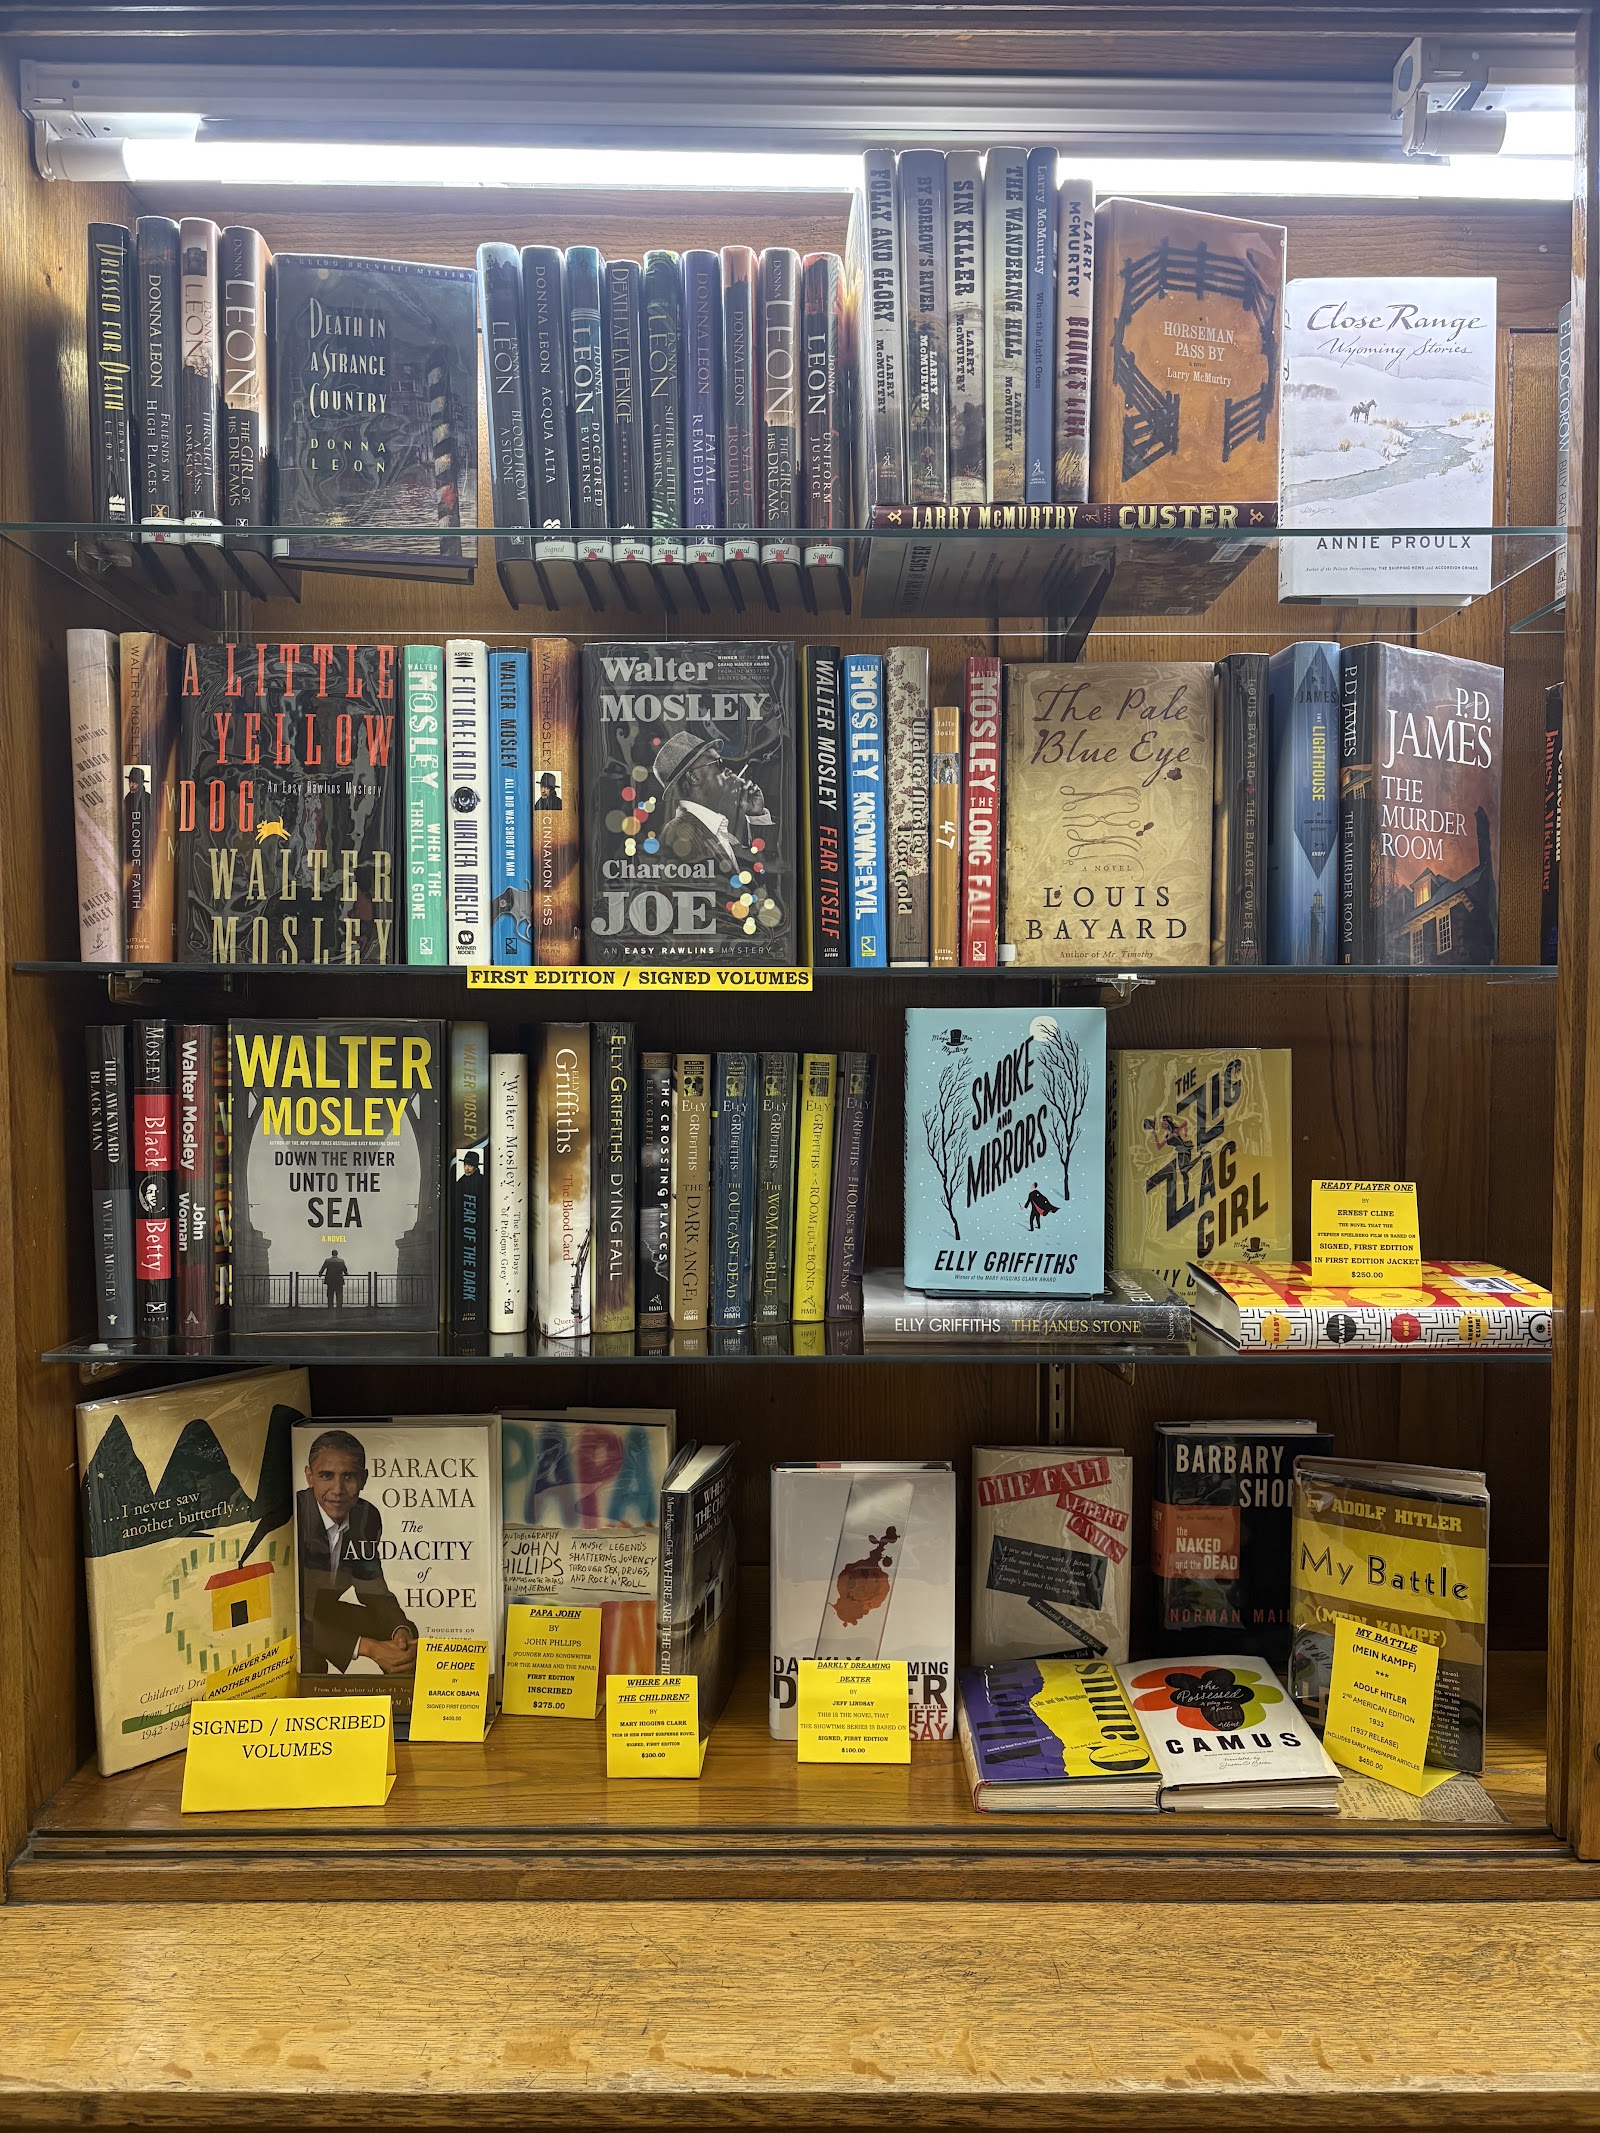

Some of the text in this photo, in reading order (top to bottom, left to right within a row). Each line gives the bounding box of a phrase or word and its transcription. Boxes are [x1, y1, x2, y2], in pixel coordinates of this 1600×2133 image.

[954, 180, 974, 296] SIN KILLER
[96, 243, 131, 411] DRESSED FOR DEATH
[310, 298, 385, 339] DEATH IN
[1307, 301, 1488, 342] Close Range
[311, 344, 385, 379] A STRANGE
[1175, 342, 1225, 362] PASS BY
[1318, 336, 1472, 369] Wyoming Stories
[1167, 368, 1231, 387] Larry McMurtry
[310, 383, 386, 418] COUNTRY
[311, 439, 385, 452] DONNA
[541, 387, 555, 483] ACQUA ALTA
[312, 458, 384, 472] LEON
[693, 415, 704, 505] REMEDIES
[706, 434, 716, 485] FATAL
[912, 506, 1078, 530] LARRY McMURTRY
[1119, 505, 1238, 529] CUSTER
[544, 545, 564, 553] Signed
[1316, 536, 1471, 550] ANNIE PROULX
[182, 643, 394, 699] A LITTLE
[600, 657, 713, 683] Walter
[600, 694, 769, 722] MOSLEY
[1033, 682, 1188, 722] The Pale
[215, 713, 394, 766] YELLOW
[409, 672, 438, 789] MOSLEY
[1382, 709, 1492, 769] JAMES
[1031, 728, 1190, 787] Blue Eye
[1313, 726, 1325, 801] LIGHTHOUSE
[268, 782, 381, 797] An Easy Rawlins Mystery
[1381, 775, 1423, 803] THE
[180, 780, 253, 832] DOG
[1381, 804, 1467, 837] MURDER
[936, 821, 955, 849] 47
[1381, 833, 1443, 861] ROOM
[411, 800, 425, 919] THRILL IS GONE
[427, 823, 441, 896] WHEN THE
[602, 859, 715, 880] Charcoal
[853, 791, 877, 920] KNOWN TO EVIL
[968, 797, 993, 924] THE LONG FALL
[208, 848, 392, 903] WALTER
[1044, 886, 1170, 908] LOUIS
[591, 891, 717, 936] JOE
[212, 916, 392, 965] MOSLEY
[1026, 918, 1187, 940] BAYARD
[471, 970, 809, 987] FIRST EDITION / SIGNED VOLUMES
[235, 1035, 432, 1090] WALTER
[972, 1035, 1034, 1131] SMOKE
[1175, 1067, 1197, 1097] THE
[556, 1049, 579, 1154] Griffiths
[1177, 1058, 1242, 1151] ZIG
[263, 1096, 409, 1136] MOSLEY
[997, 1109, 1012, 1133] AND
[274, 1152, 395, 1167] DOWN THE RIVER
[967, 1104, 1048, 1208] MIRRORS
[290, 1172, 380, 1192] UNTO THE
[1146, 1140, 1236, 1232] ZAG
[1320, 1182, 1413, 1192] READY PLAYER ONE
[308, 1197, 363, 1228] SEA
[1197, 1171, 1269, 1259] GIRL
[934, 1250, 1078, 1274] ELLY GRIFFITHS
[894, 1318, 1140, 1335] ELLY GRIFFITHS THE JANUS STONE
[371, 1457, 479, 1478] BARACK
[1176, 1444, 1284, 1474] BARBARY
[134, 1492, 201, 1517] never saw
[382, 1488, 476, 1508] OBAMA
[122, 1515, 174, 1538] another
[401, 1520, 423, 1534] The
[1332, 1499, 1462, 1533] ADOLF HITLER
[1176, 1526, 1187, 1536] the
[343, 1540, 474, 1561] AUDACITY
[1176, 1538, 1221, 1553] NAKED
[417, 1566, 431, 1583] of
[1176, 1555, 1238, 1570] and the DEAD
[1300, 1541, 1469, 1600] My Battle
[404, 1588, 477, 1608] HOPE
[556, 1610, 582, 1618] JOHN
[444, 1645, 486, 1653] AUDACITY
[1356, 1627, 1418, 1653] MY BATTLE
[451, 1662, 475, 1670] HOPE
[1352, 1644, 1417, 1672] (MEIN KAMPF)
[528, 1686, 573, 1694] INSCRIBED
[1353, 1681, 1407, 1705] ADOLF HITLER
[533, 1701, 565, 1709] $275.00
[192, 1715, 386, 1736] SIGNED / INSCRIBED
[1369, 1717, 1384, 1728] 1933
[242, 1742, 333, 1759] VOLUMES
[1166, 1733, 1301, 1754] CAMUS
[1359, 1756, 1384, 1771] $450.00
